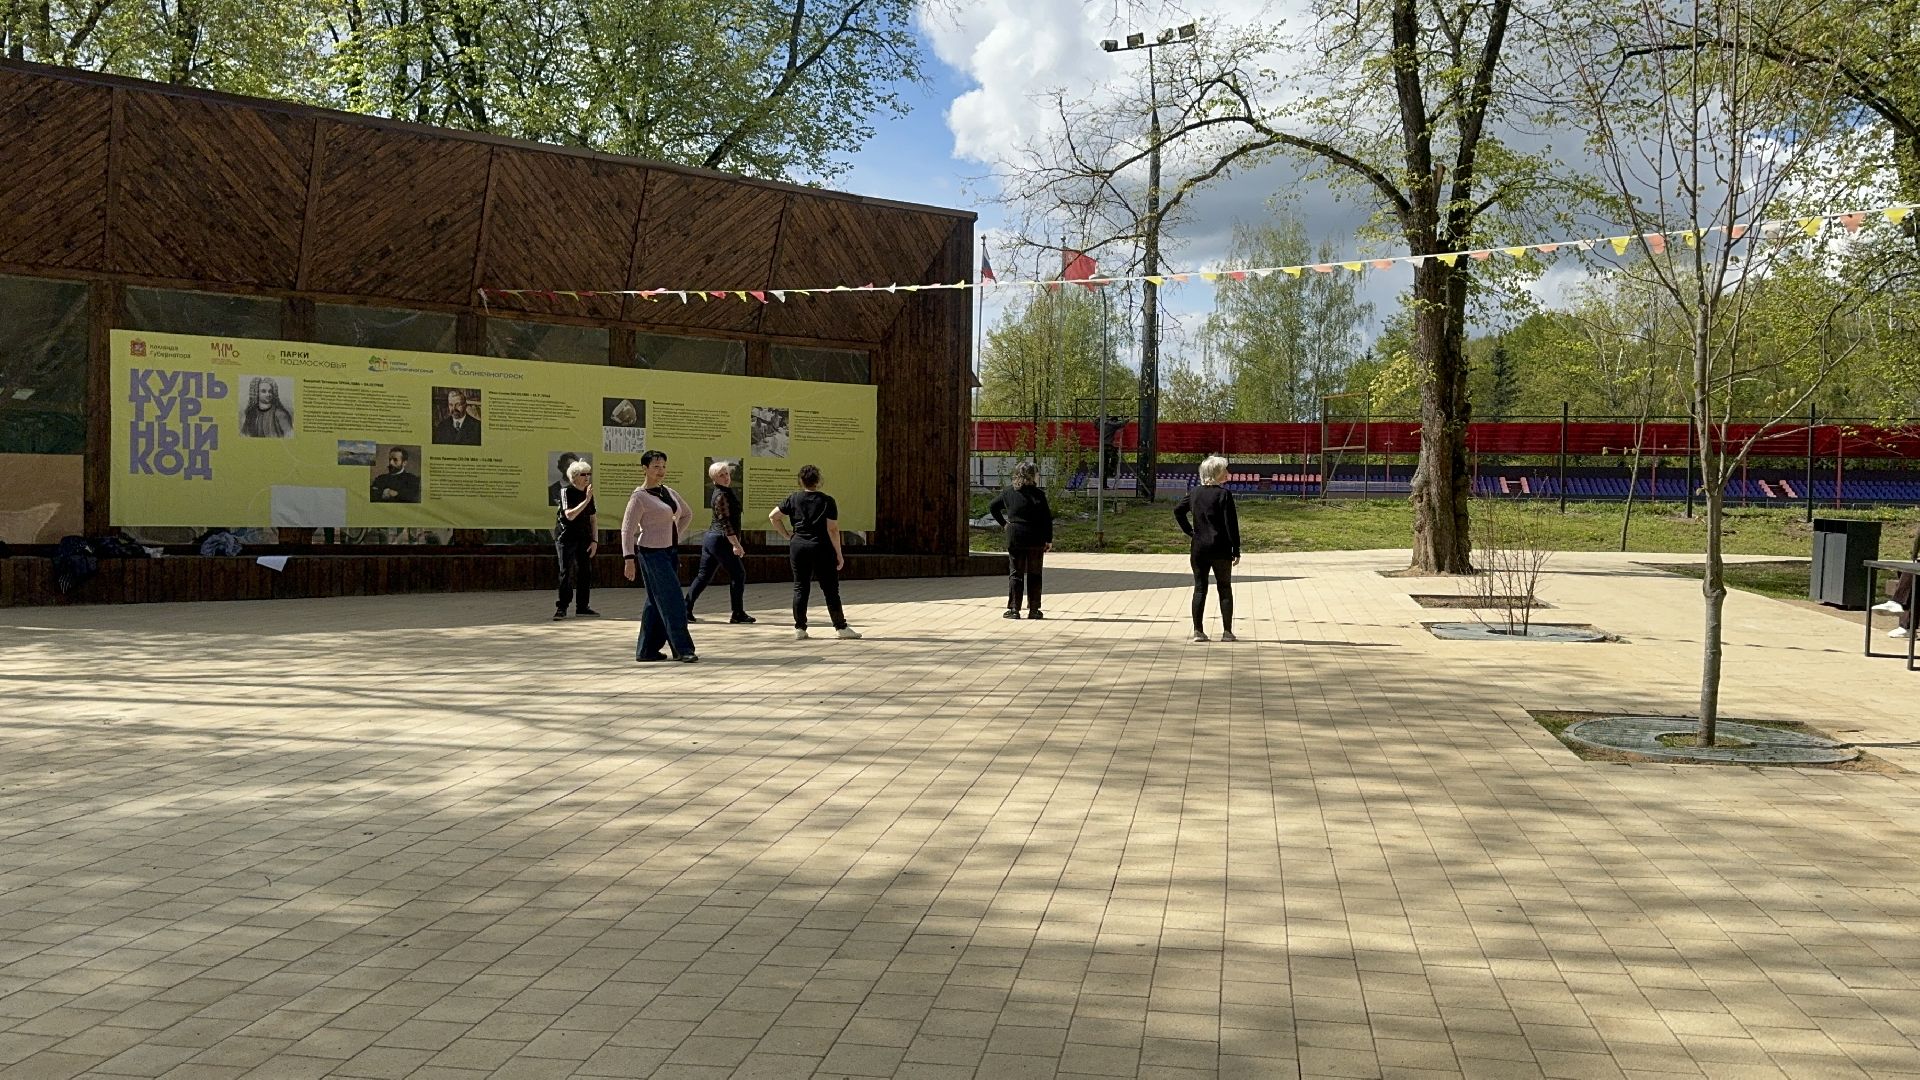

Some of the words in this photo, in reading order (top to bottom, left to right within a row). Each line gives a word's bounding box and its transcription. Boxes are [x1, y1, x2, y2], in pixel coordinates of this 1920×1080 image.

[280, 351, 310, 359] ПАРКИ
[280, 358, 347, 369] ПОДМОСКОВЬЯ
[130, 368, 228, 399] КУЛЬ
[130, 417, 219, 450] НЫЙ
[130, 448, 213, 480] КОД
